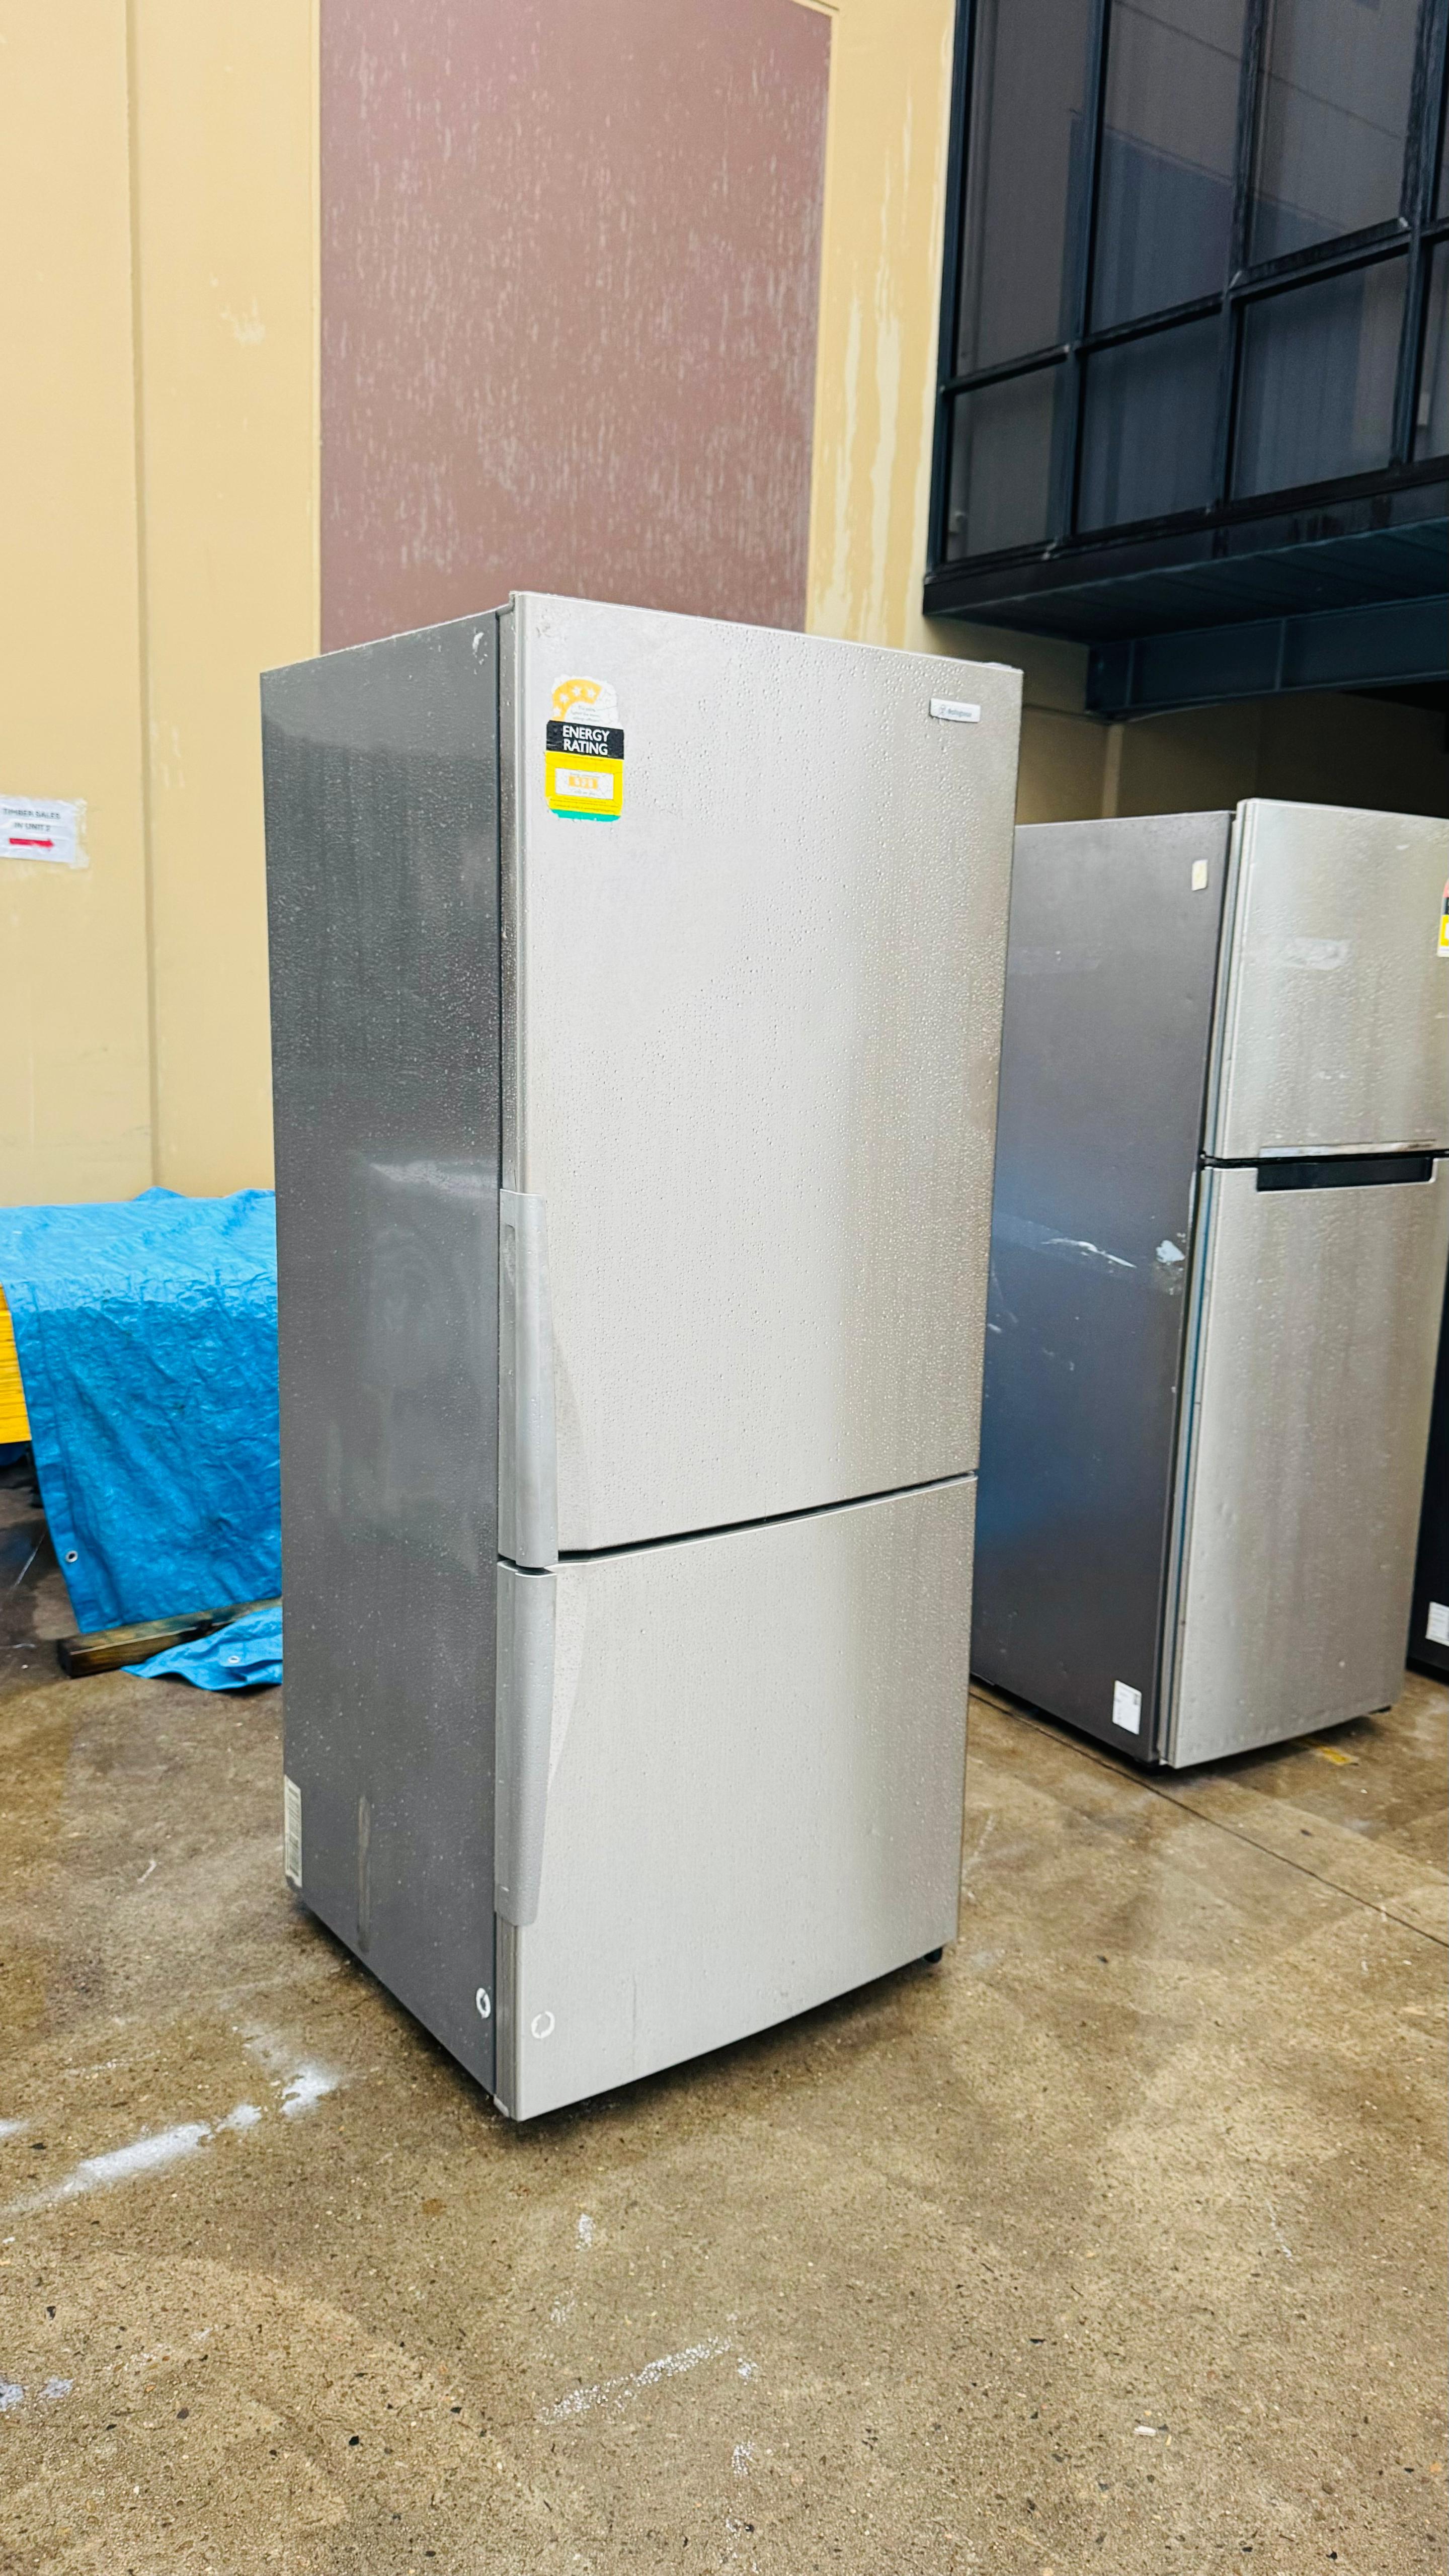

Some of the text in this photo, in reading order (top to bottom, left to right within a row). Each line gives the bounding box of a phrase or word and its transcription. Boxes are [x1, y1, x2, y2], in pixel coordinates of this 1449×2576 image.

[562, 725, 610, 742] ENERGY
[564, 739, 608, 755] RATING
[3, 809, 61, 820] TIMBER SALES
[25, 823, 44, 831] UNIT
